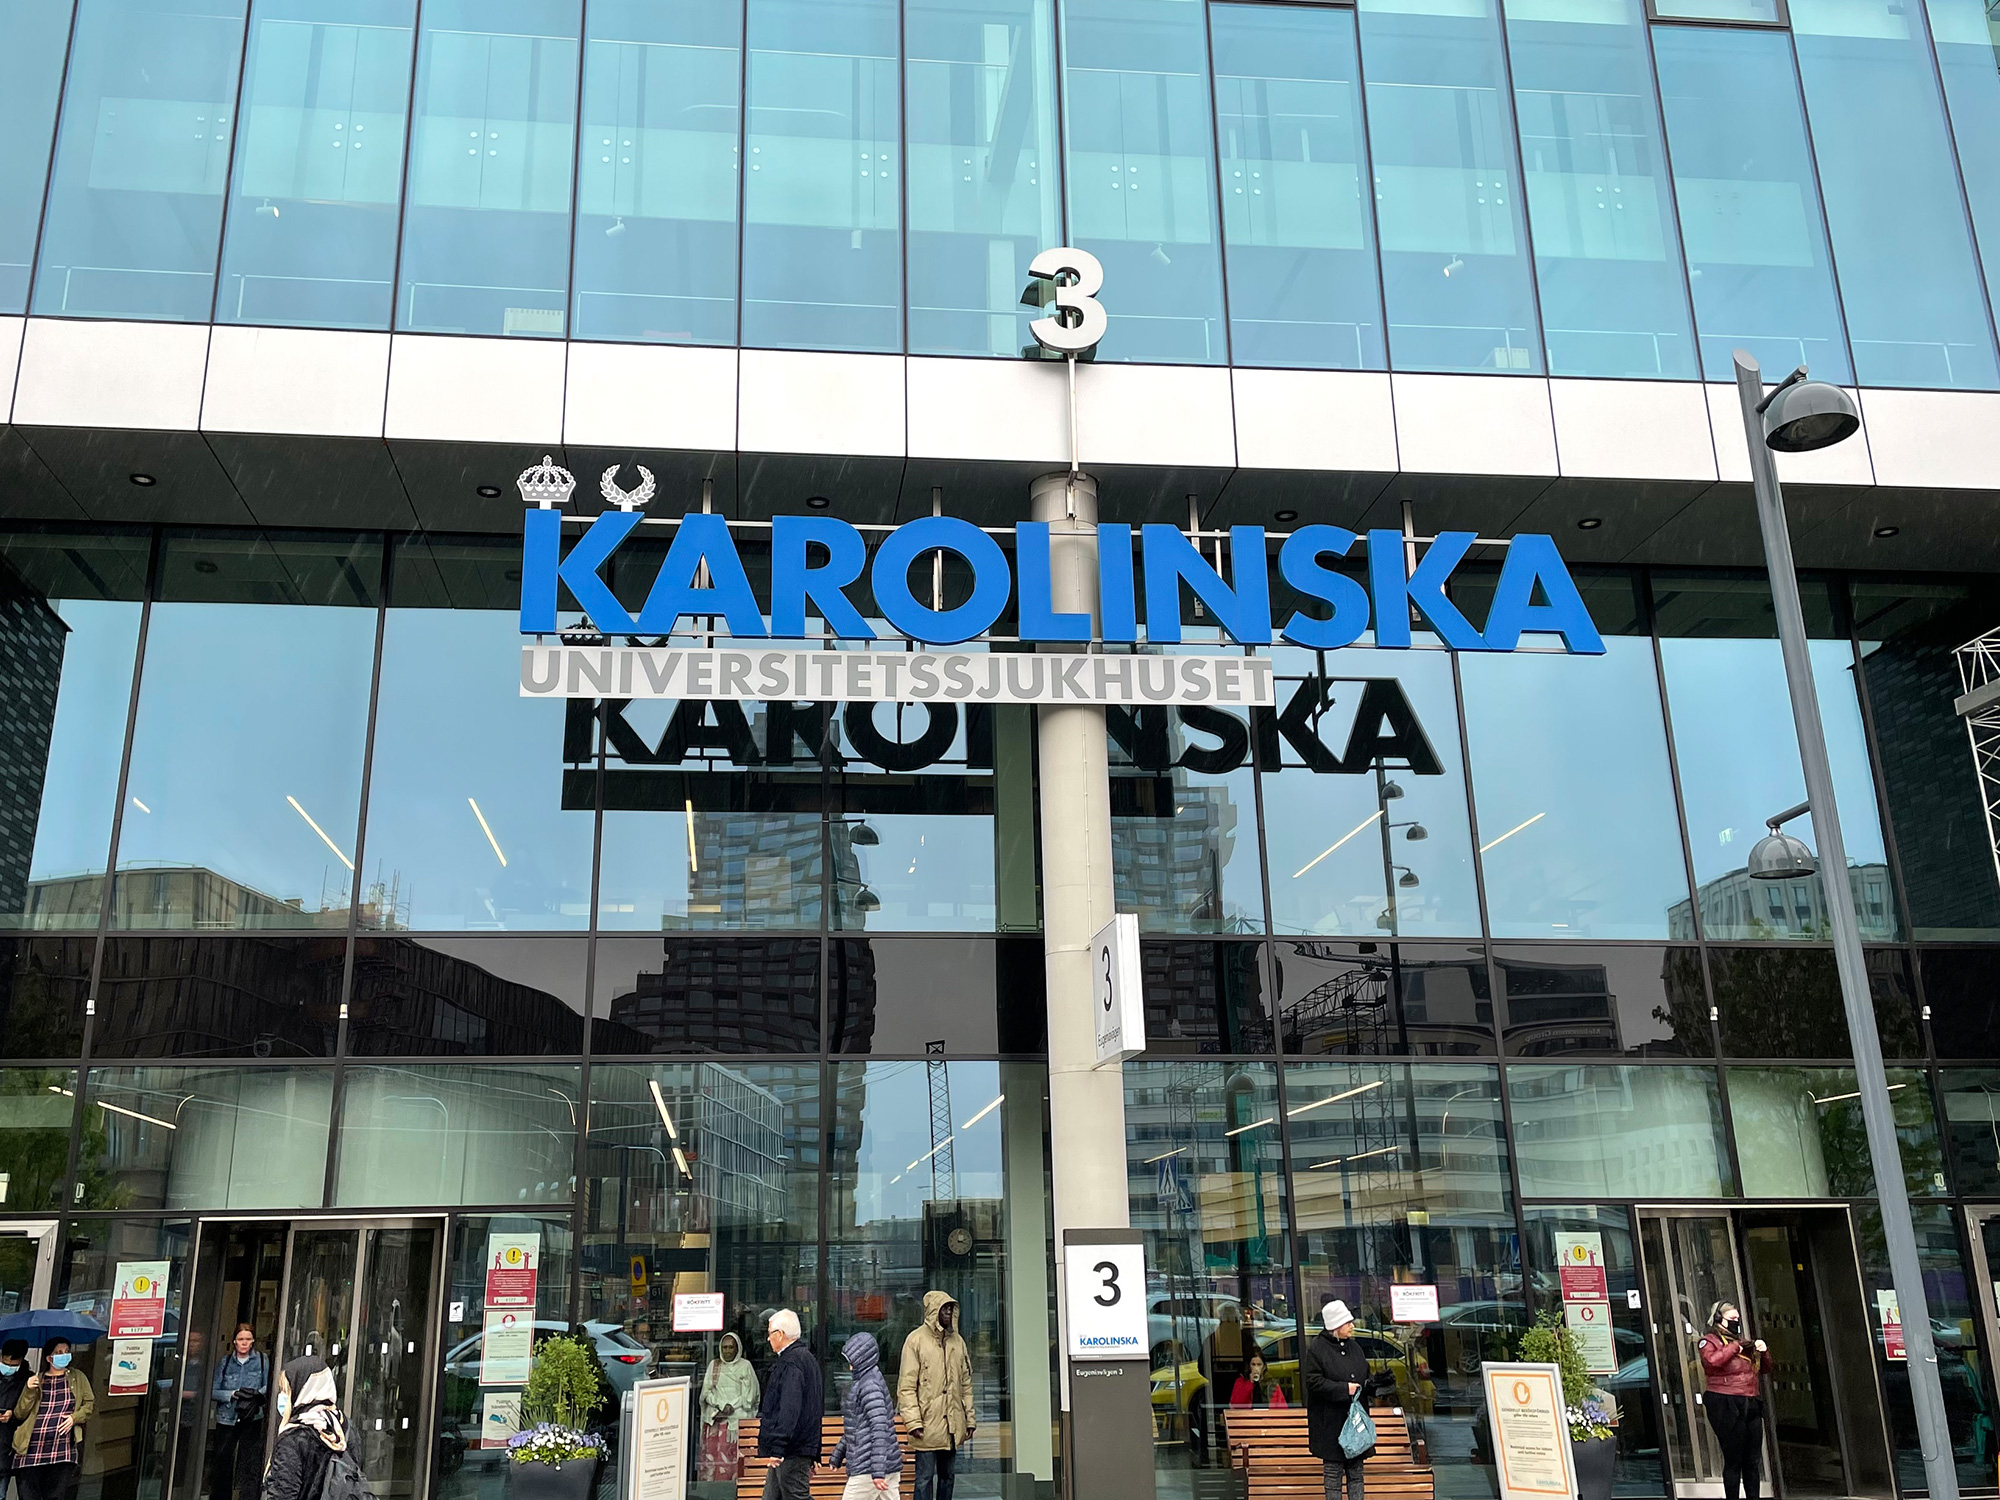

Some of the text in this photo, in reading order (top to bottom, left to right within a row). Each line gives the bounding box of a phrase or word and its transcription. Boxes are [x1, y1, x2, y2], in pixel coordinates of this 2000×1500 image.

[1027, 247, 1108, 354] 3
[519, 508, 1605, 655] KAROLINSKA
[522, 649, 1271, 706] UNIVERSITETSSJUKHUSET
[1102, 945, 1113, 1012] 3
[1093, 1261, 1121, 1307] 3
[1080, 1336, 1139, 1346] KAROLINSKA
